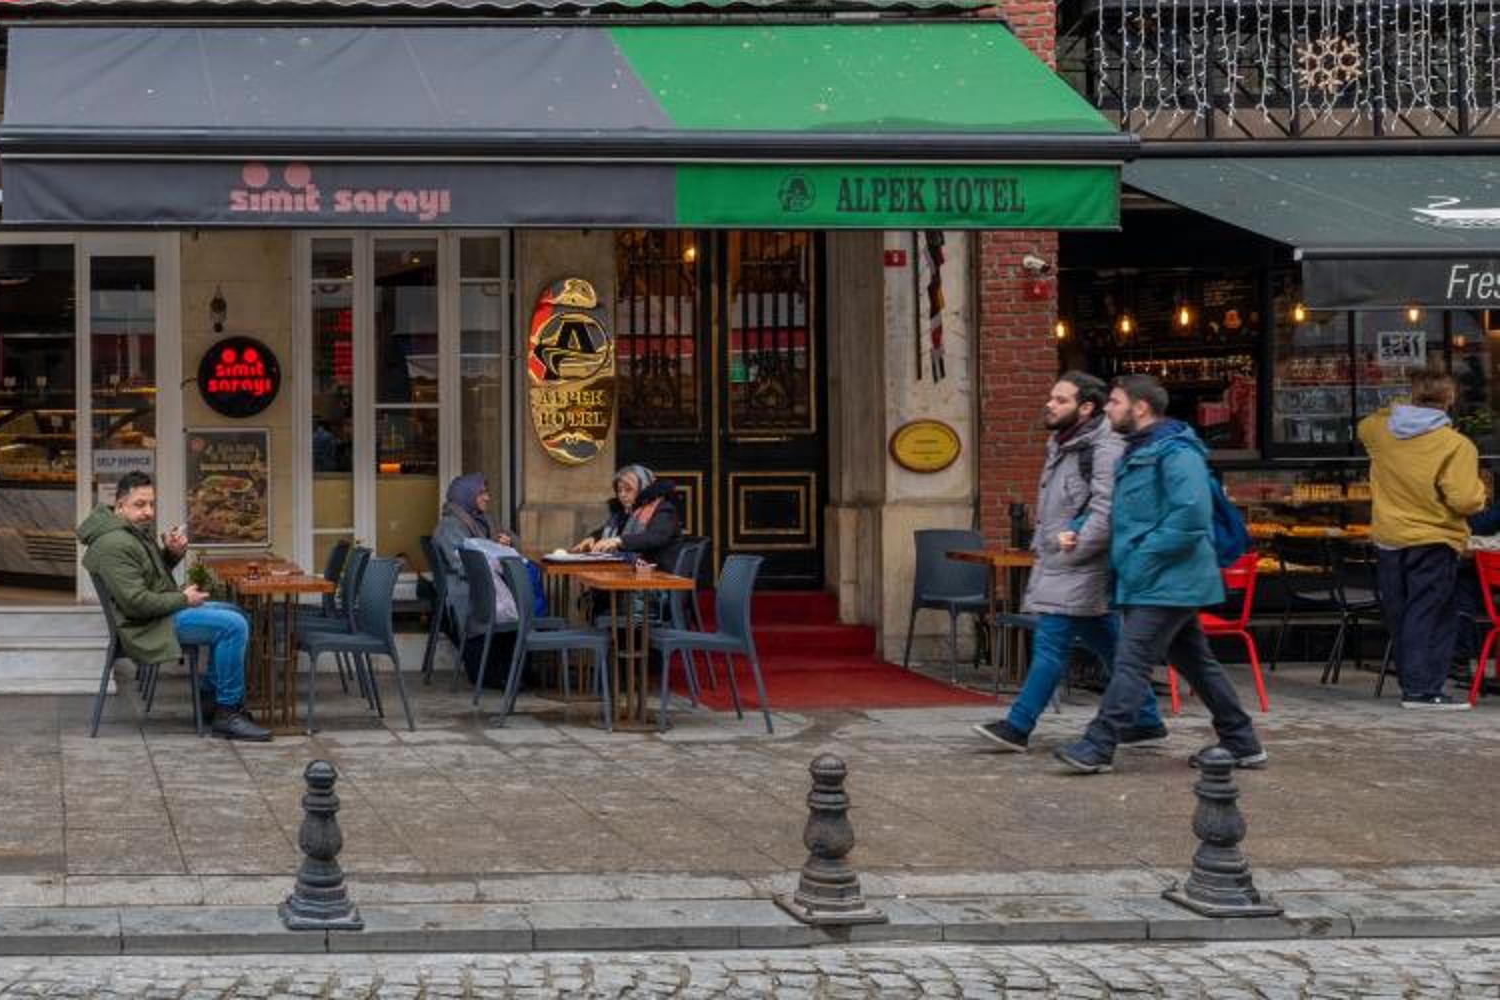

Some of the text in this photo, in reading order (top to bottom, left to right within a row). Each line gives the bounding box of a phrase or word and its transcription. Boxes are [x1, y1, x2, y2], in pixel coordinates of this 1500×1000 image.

[229, 163, 321, 212] simit
[836, 177, 1025, 213] ALPEK HOTEL
